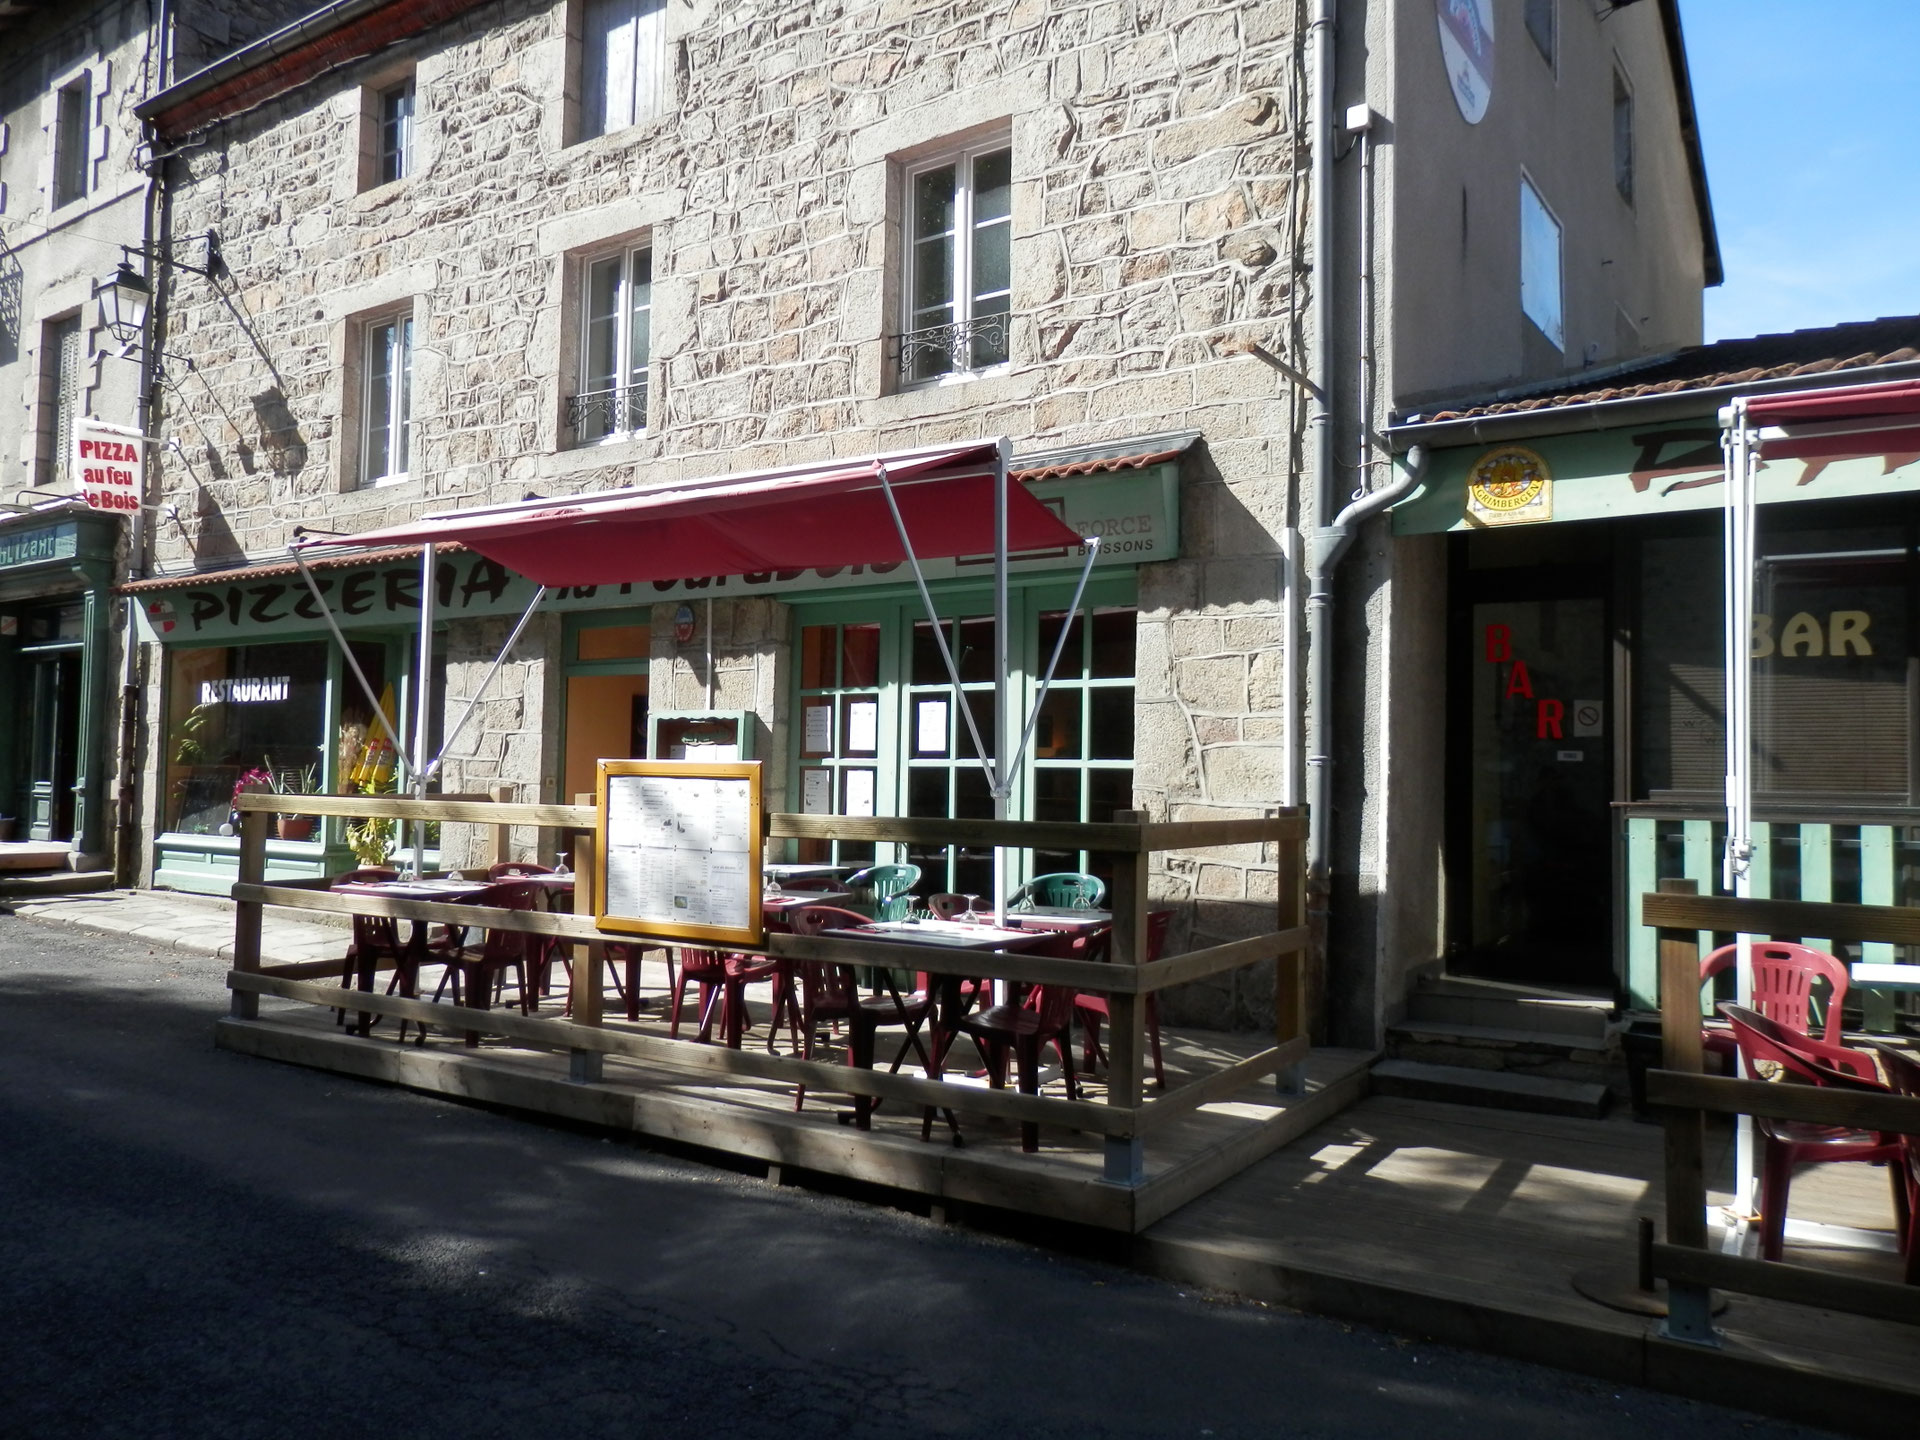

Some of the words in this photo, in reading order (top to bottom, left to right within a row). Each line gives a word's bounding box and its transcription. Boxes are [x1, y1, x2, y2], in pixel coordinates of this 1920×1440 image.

[80, 440, 138, 462] PIZZA
[84, 468, 104, 483] au
[107, 466, 133, 485] feu
[101, 490, 139, 510] Bois
[1477, 483, 1539, 508] GRIMBERGEN
[1076, 515, 1152, 537] FORCE
[186, 556, 511, 631] PIZZERIA
[1750, 610, 1873, 658] BAR
[201, 676, 290, 703] RESTAURANT
[1485, 623, 1565, 739] BAR
